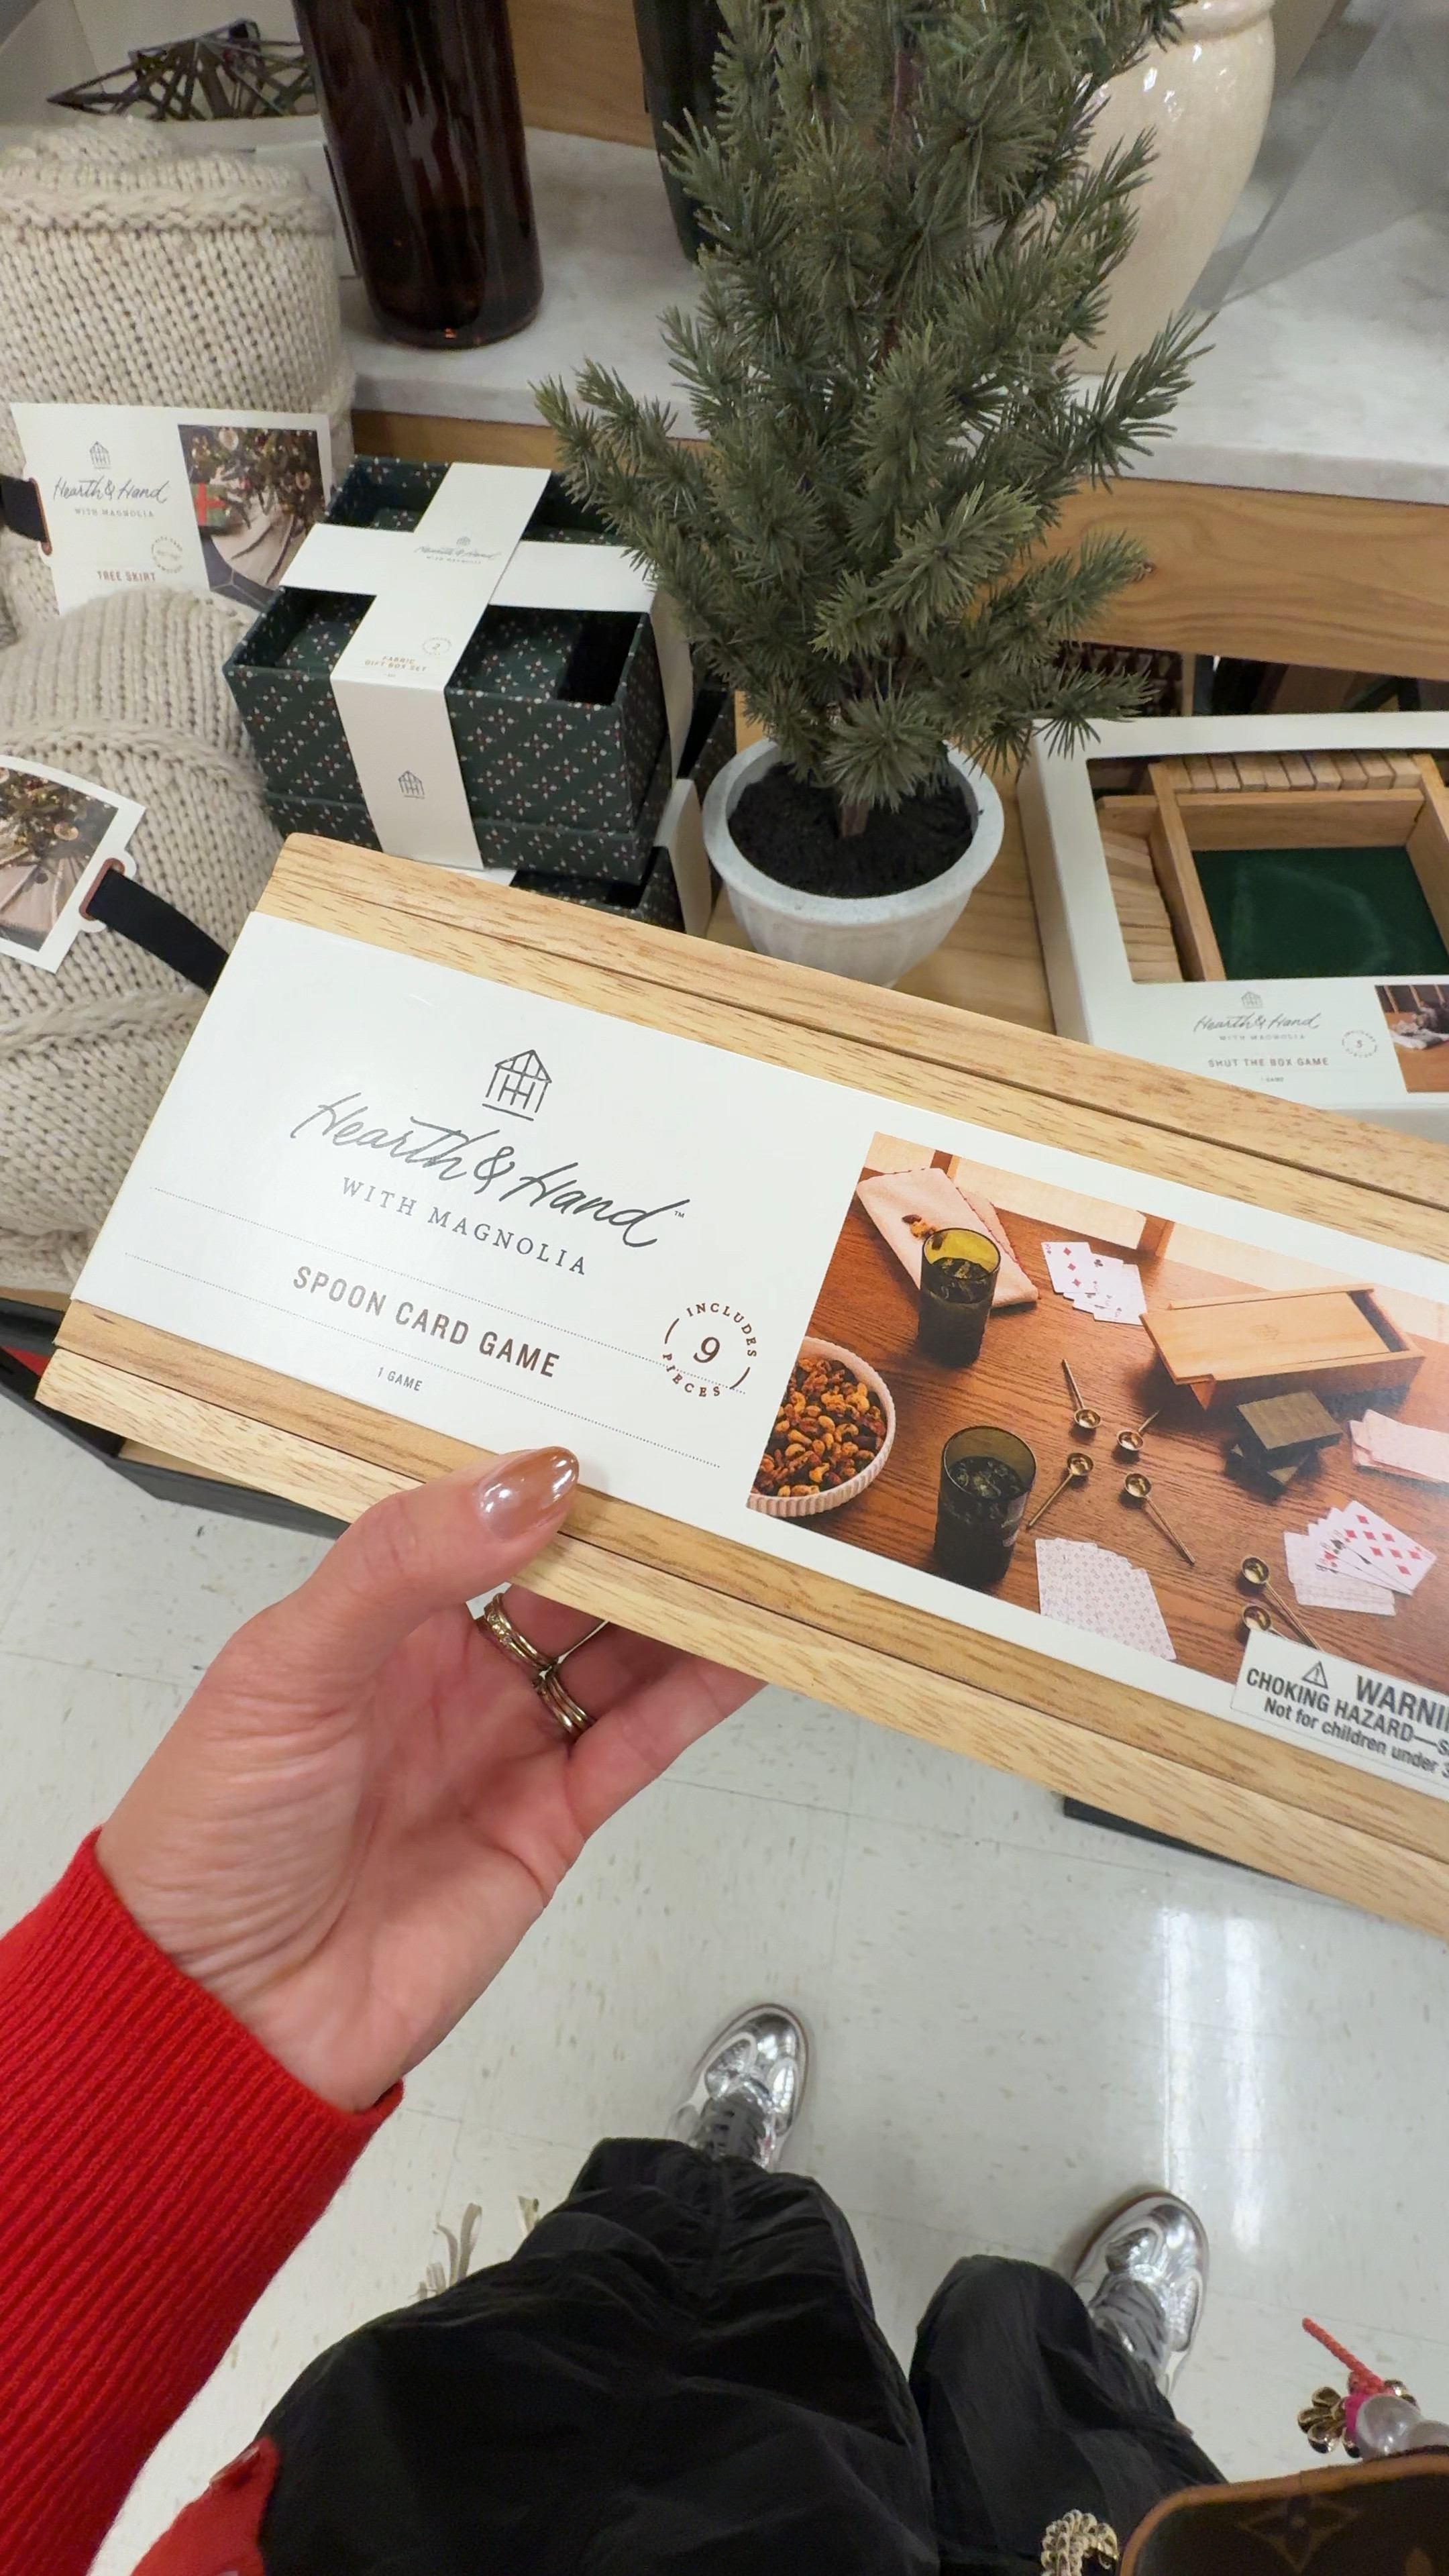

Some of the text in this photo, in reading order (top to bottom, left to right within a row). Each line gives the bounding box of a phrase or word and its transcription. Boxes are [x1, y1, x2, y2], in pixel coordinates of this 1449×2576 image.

[54, 475, 169, 503] Hearth & Hand
[97, 570, 156, 582] TREE SKIRT
[1193, 1011, 1254, 1032] Hearth
[1268, 1012, 1322, 1029] Hand
[1208, 1057, 1329, 1068] SHUT THE BOX GAME
[290, 1091, 500, 1181] Hearth
[474, 1145, 515, 1195] &
[498, 1162, 690, 1248] Hand
[343, 1177, 586, 1275] WITH MAGNOLIA
[292, 1265, 560, 1378] SPOON CARD GAME
[686, 1302, 757, 1358] INCLUDES
[693, 1336, 720, 1363] 9
[377, 1366, 423, 1392] 1 GAME
[662, 1352, 720, 1398] PIECES
[1246, 1668, 1330, 1711] CHOKING
[1356, 1674, 1449, 1733] WARNI
[1264, 1697, 1292, 1721] Not
[1295, 1709, 1319, 1729] for
[1321, 1719, 1387, 1756] children
[1391, 1748, 1440, 1774] under
